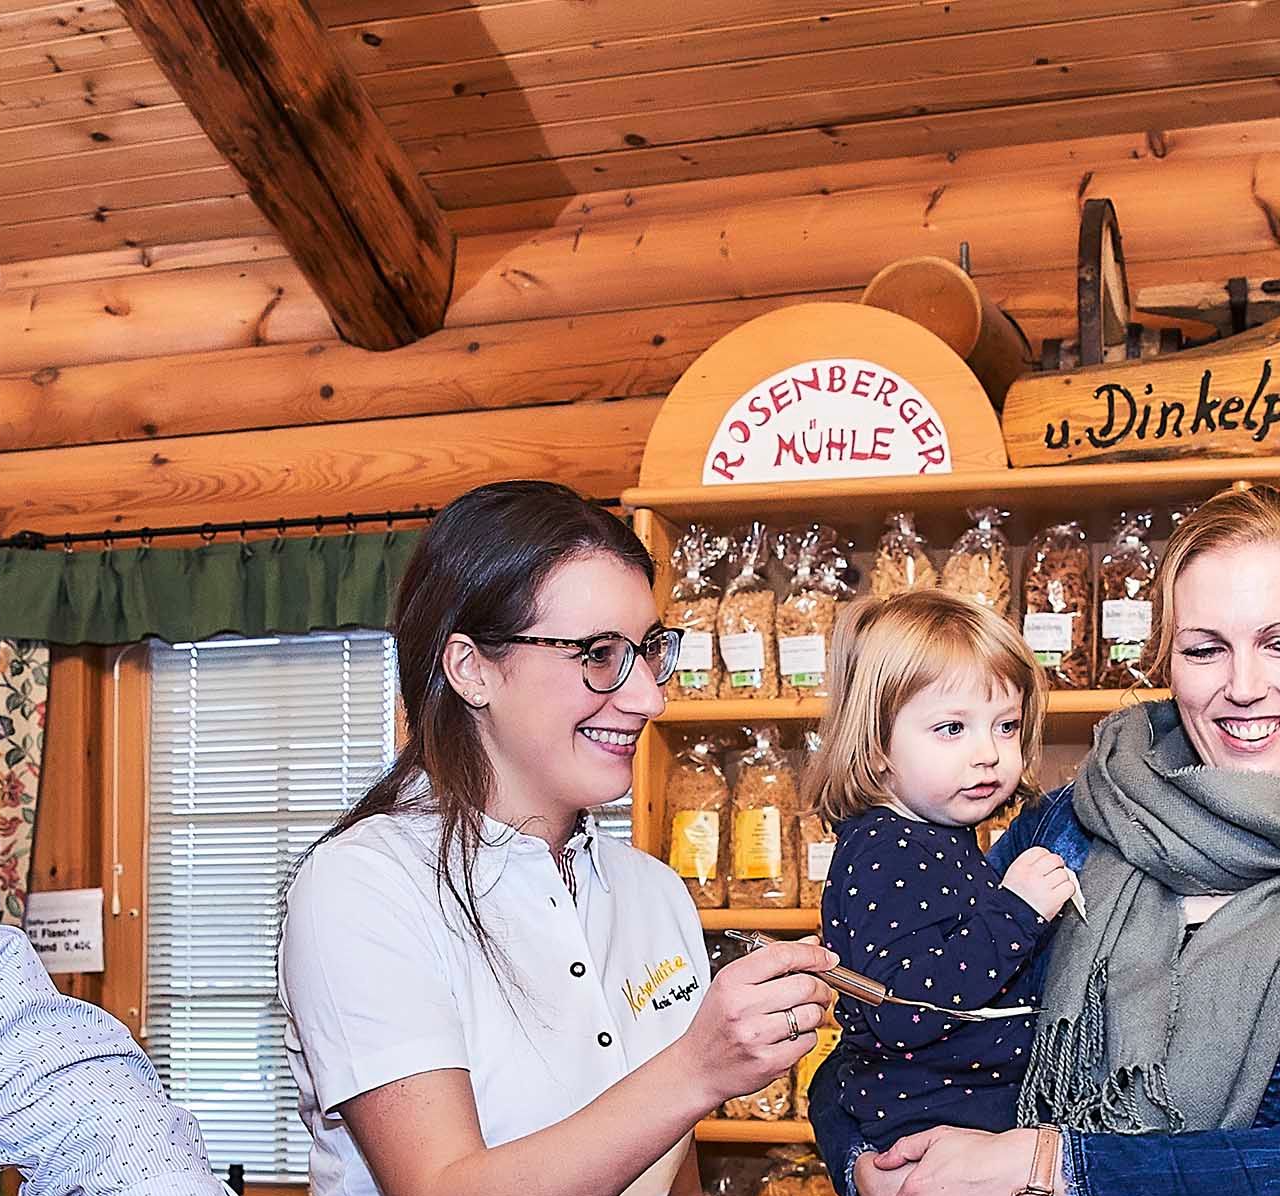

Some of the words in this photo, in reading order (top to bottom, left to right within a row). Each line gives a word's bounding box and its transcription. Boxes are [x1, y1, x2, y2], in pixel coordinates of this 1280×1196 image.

[711, 365, 946, 480] ROSENBERGER
[773, 418, 896, 468] MÜHLE
[1043, 418, 1083, 450] u.
